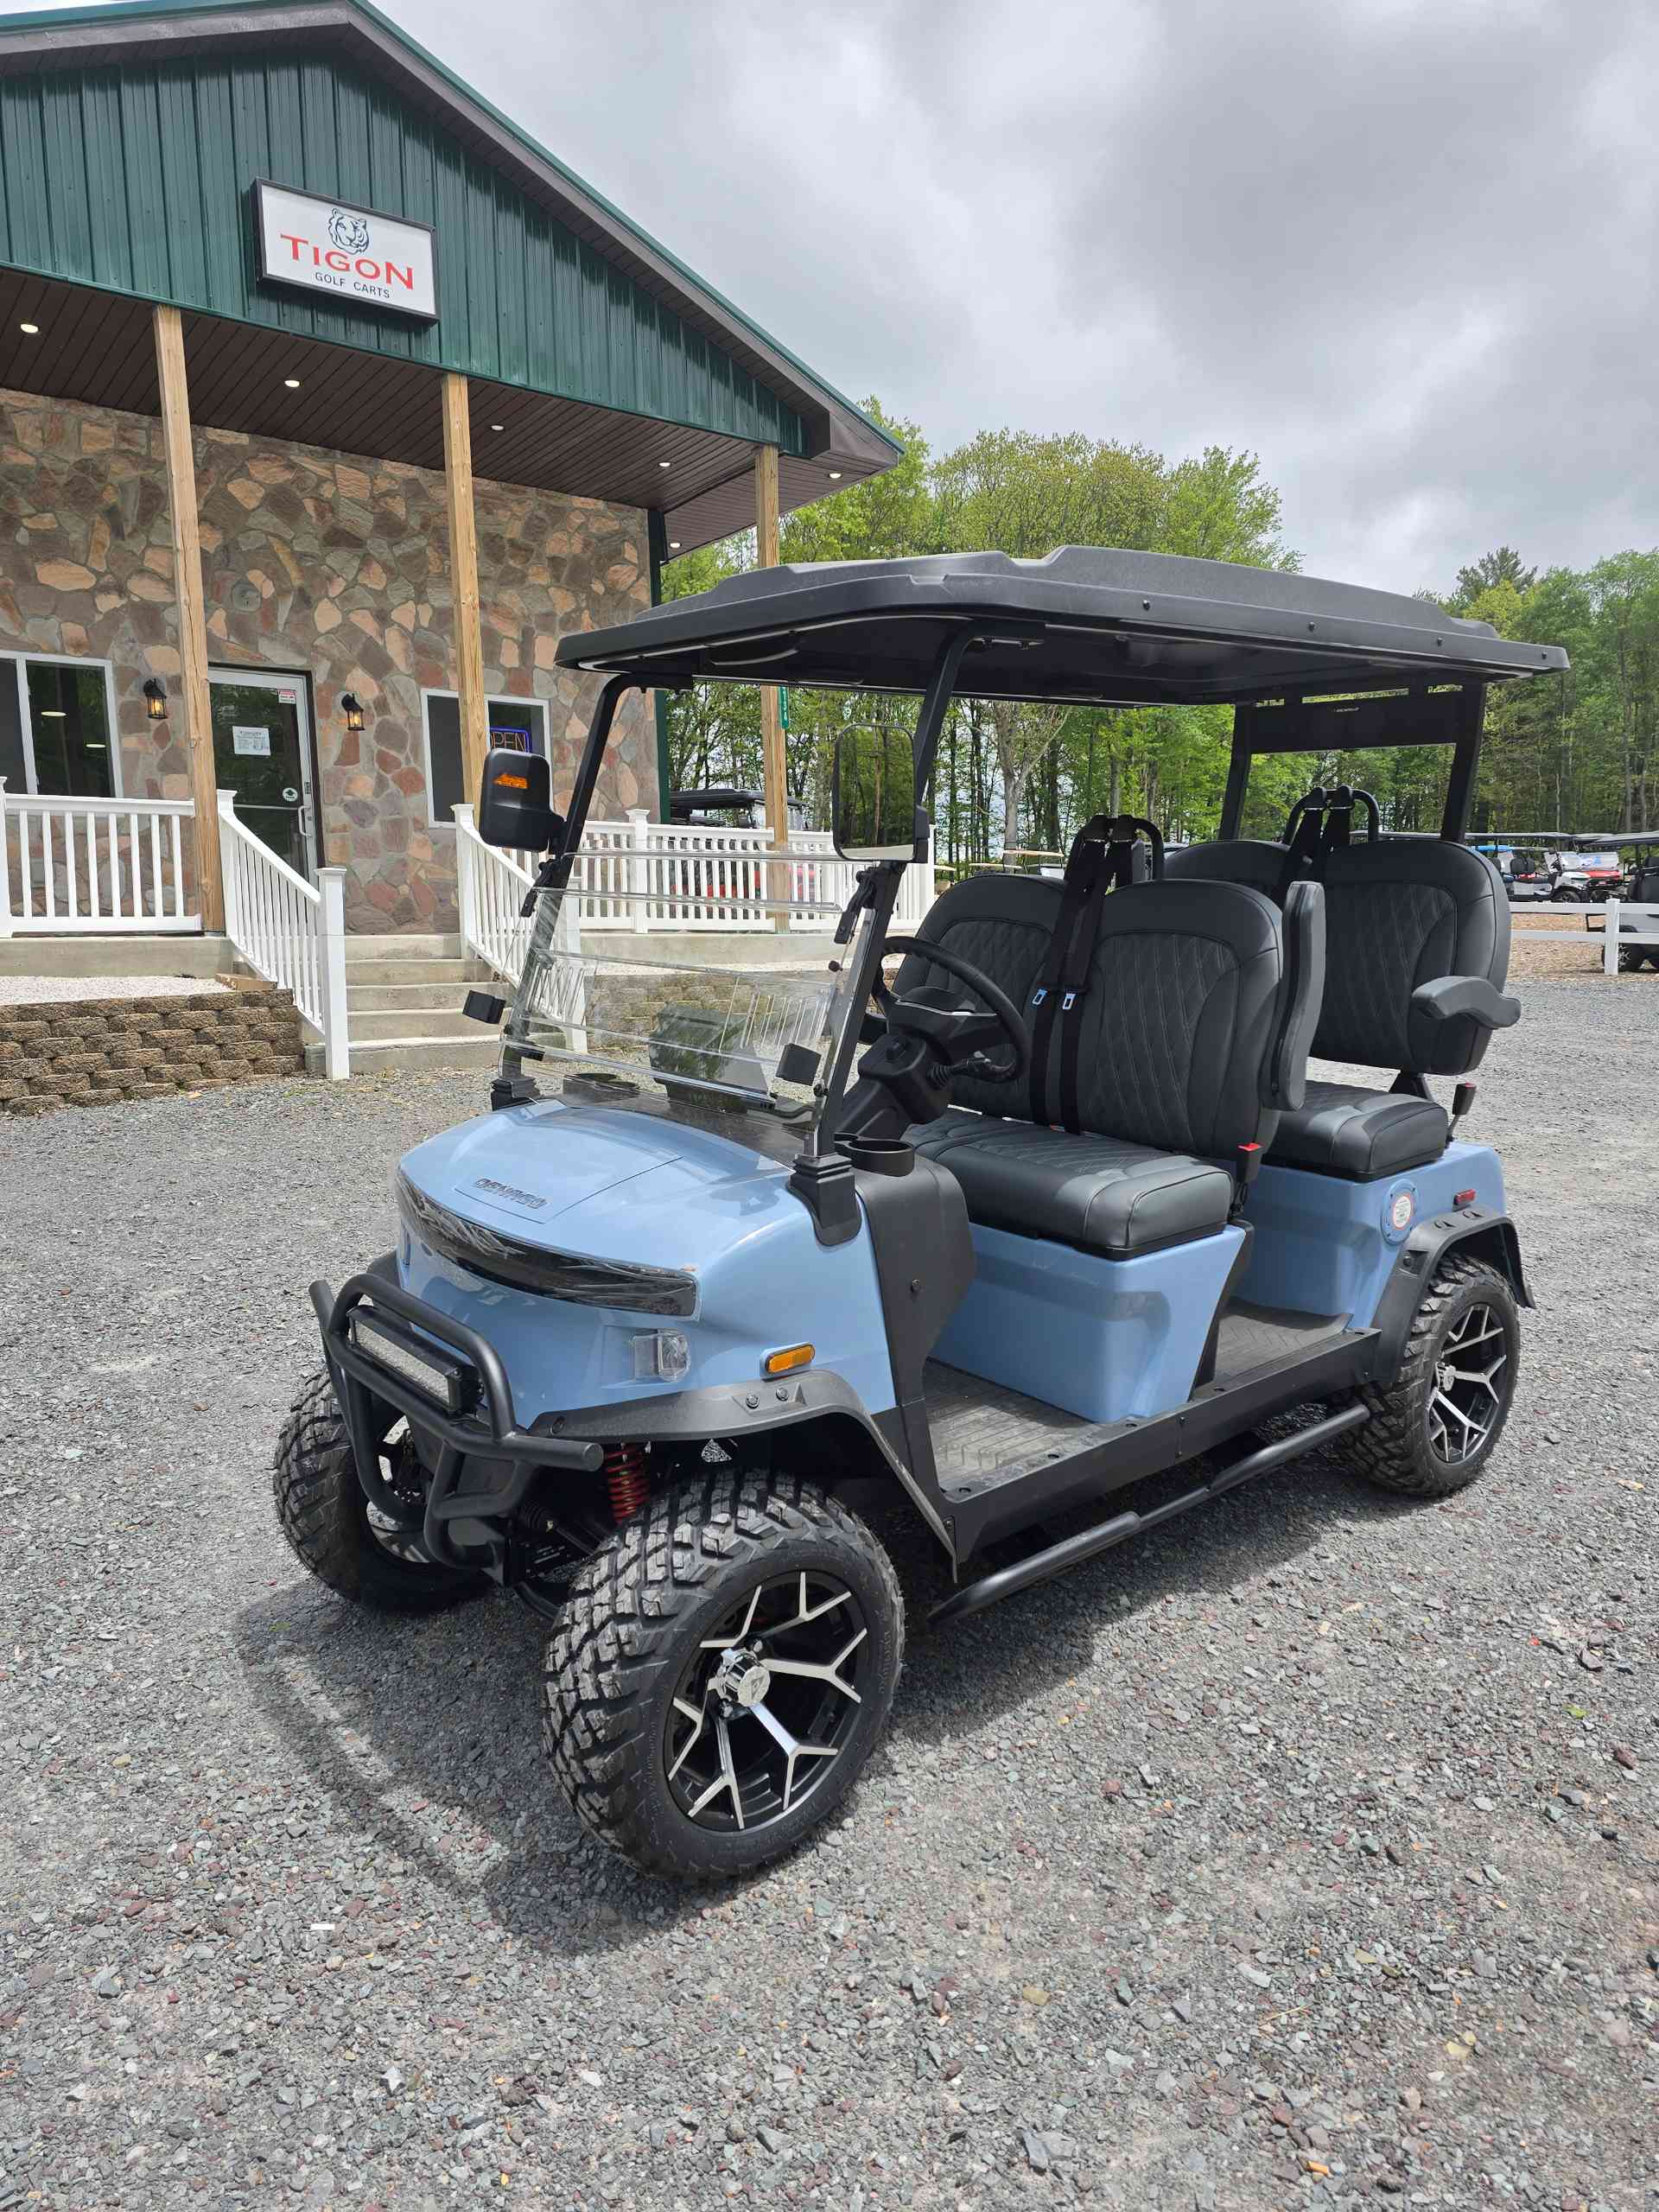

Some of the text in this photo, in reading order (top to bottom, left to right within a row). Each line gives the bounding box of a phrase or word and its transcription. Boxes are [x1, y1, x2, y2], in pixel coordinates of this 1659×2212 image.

[281, 234, 413, 289] TIGON
[315, 272, 390, 298] GOLF CARTS
[490, 732, 526, 752] PEN
